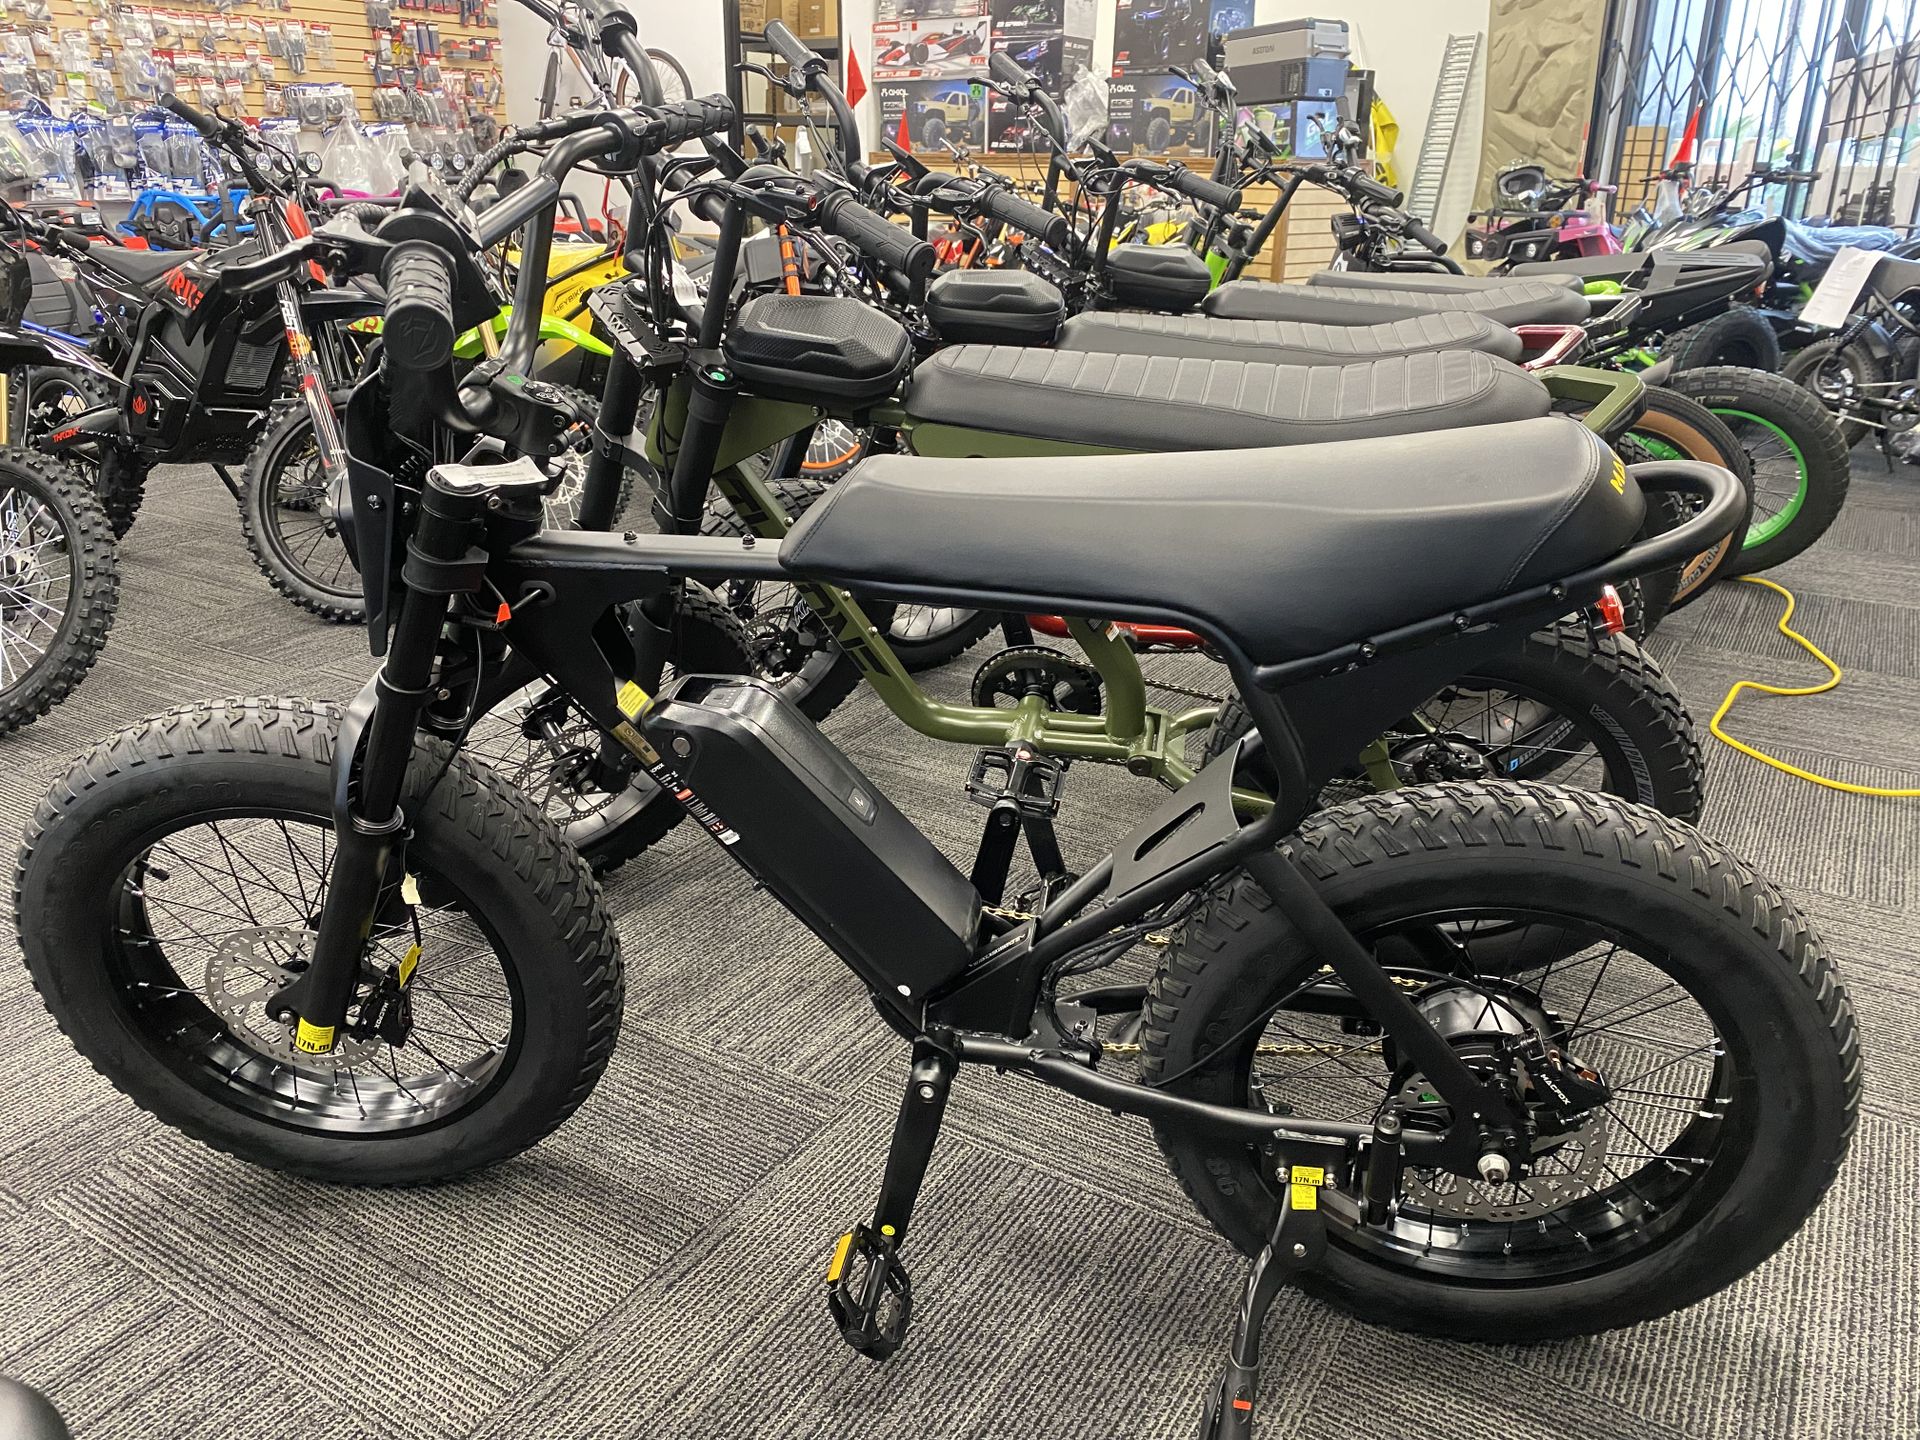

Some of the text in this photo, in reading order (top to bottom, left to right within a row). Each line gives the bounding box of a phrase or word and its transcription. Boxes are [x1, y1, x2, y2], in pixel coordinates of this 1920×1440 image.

[374, 1001, 390, 1029] MACFOX
[298, 1036, 330, 1052] 17N.m
[1540, 1072, 1572, 1106] MACFOX
[1294, 1176, 1320, 1185] 17N.m
